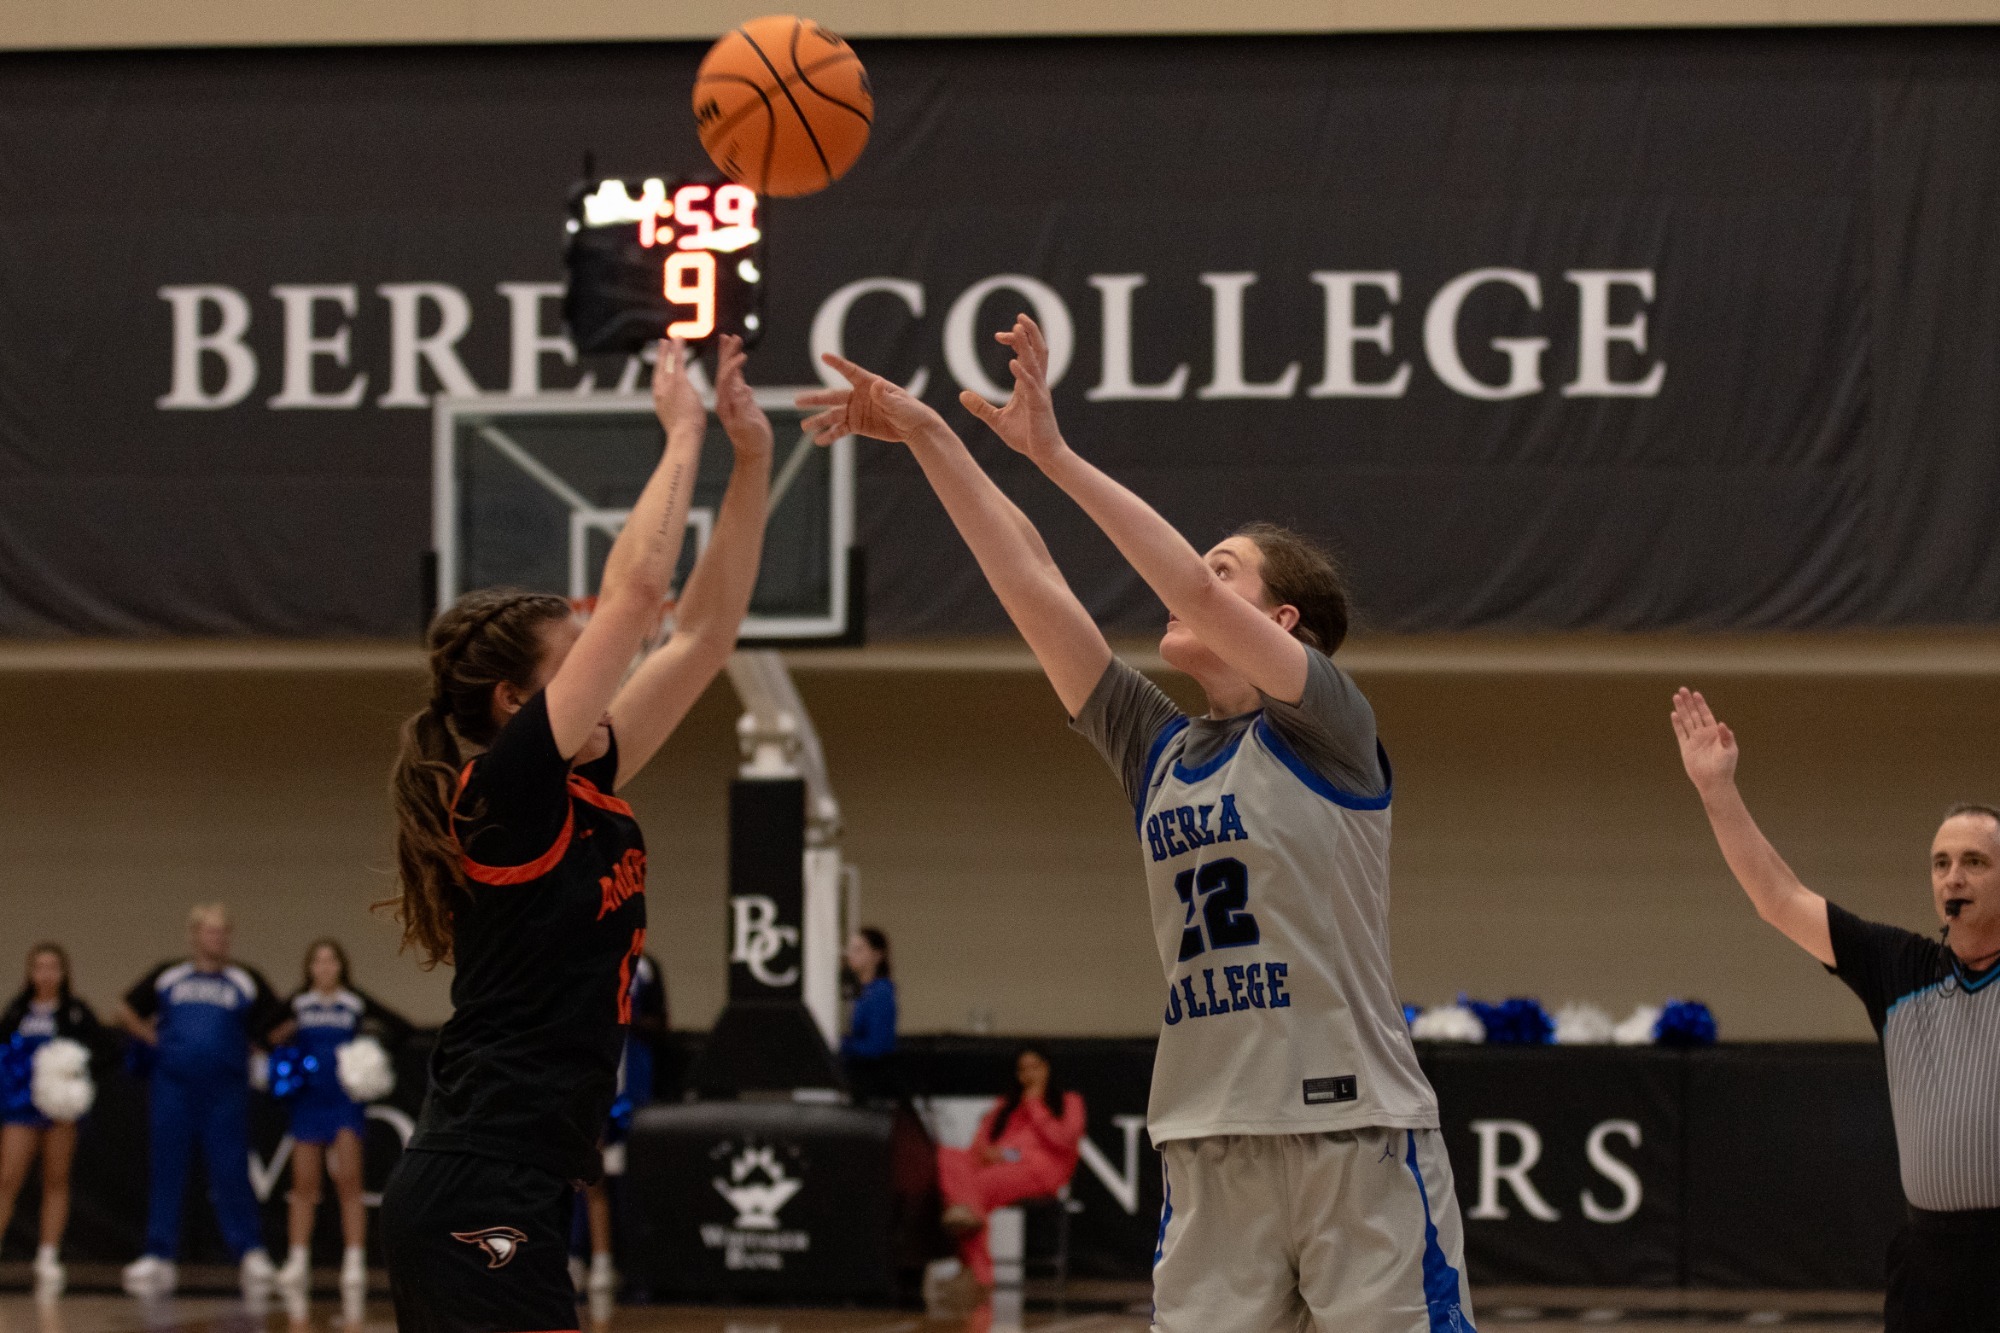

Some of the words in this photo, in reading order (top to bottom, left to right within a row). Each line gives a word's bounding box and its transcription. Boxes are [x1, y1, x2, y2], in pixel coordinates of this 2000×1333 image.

[663, 250, 716, 339] 9
[810, 267, 1667, 401] COLLEGE
[731, 894, 799, 987] BC
[1164, 962, 1291, 1026] OLLEGE
